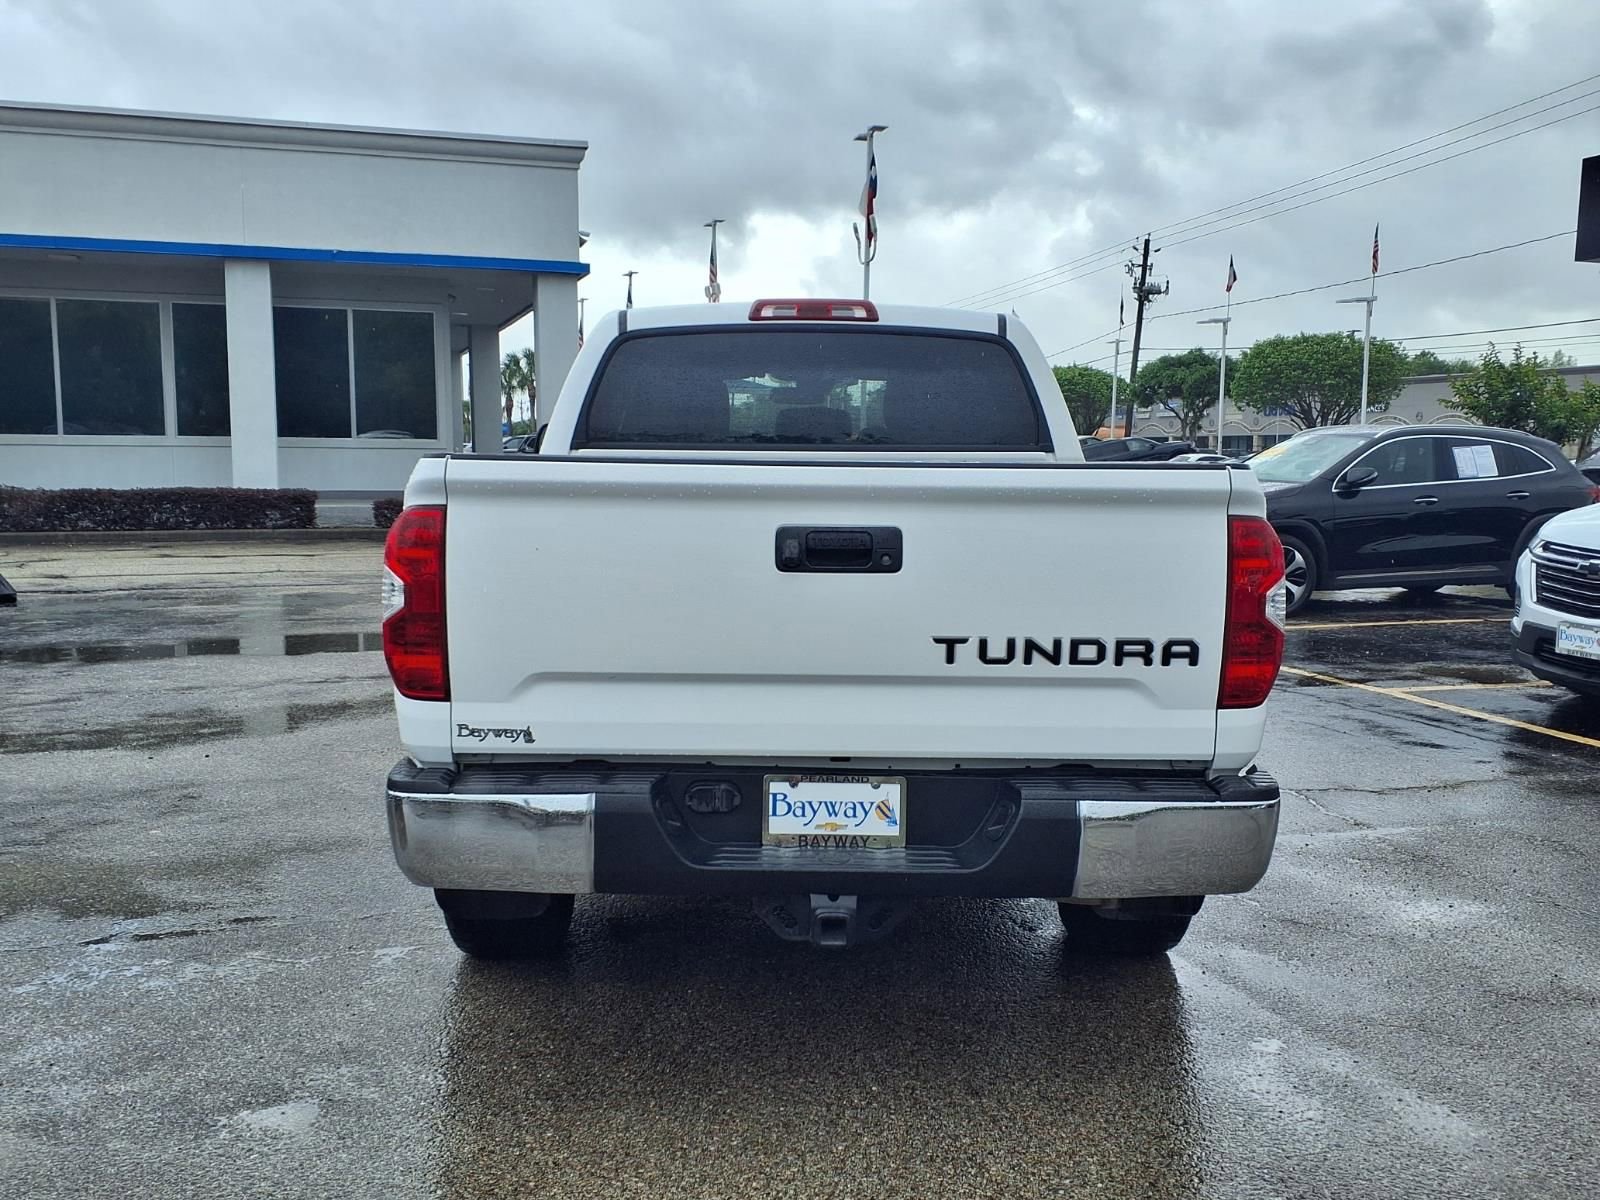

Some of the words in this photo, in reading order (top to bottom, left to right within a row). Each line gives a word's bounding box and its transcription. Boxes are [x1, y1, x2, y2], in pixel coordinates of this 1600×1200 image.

[1560, 628, 1594, 648] Bayway
[931, 636, 1200, 667] TUNDRA
[456, 724, 526, 743] Bayway
[800, 775, 870, 783] PEARLAND
[769, 792, 874, 827] Bayway
[798, 835, 869, 848] BAYWAY
